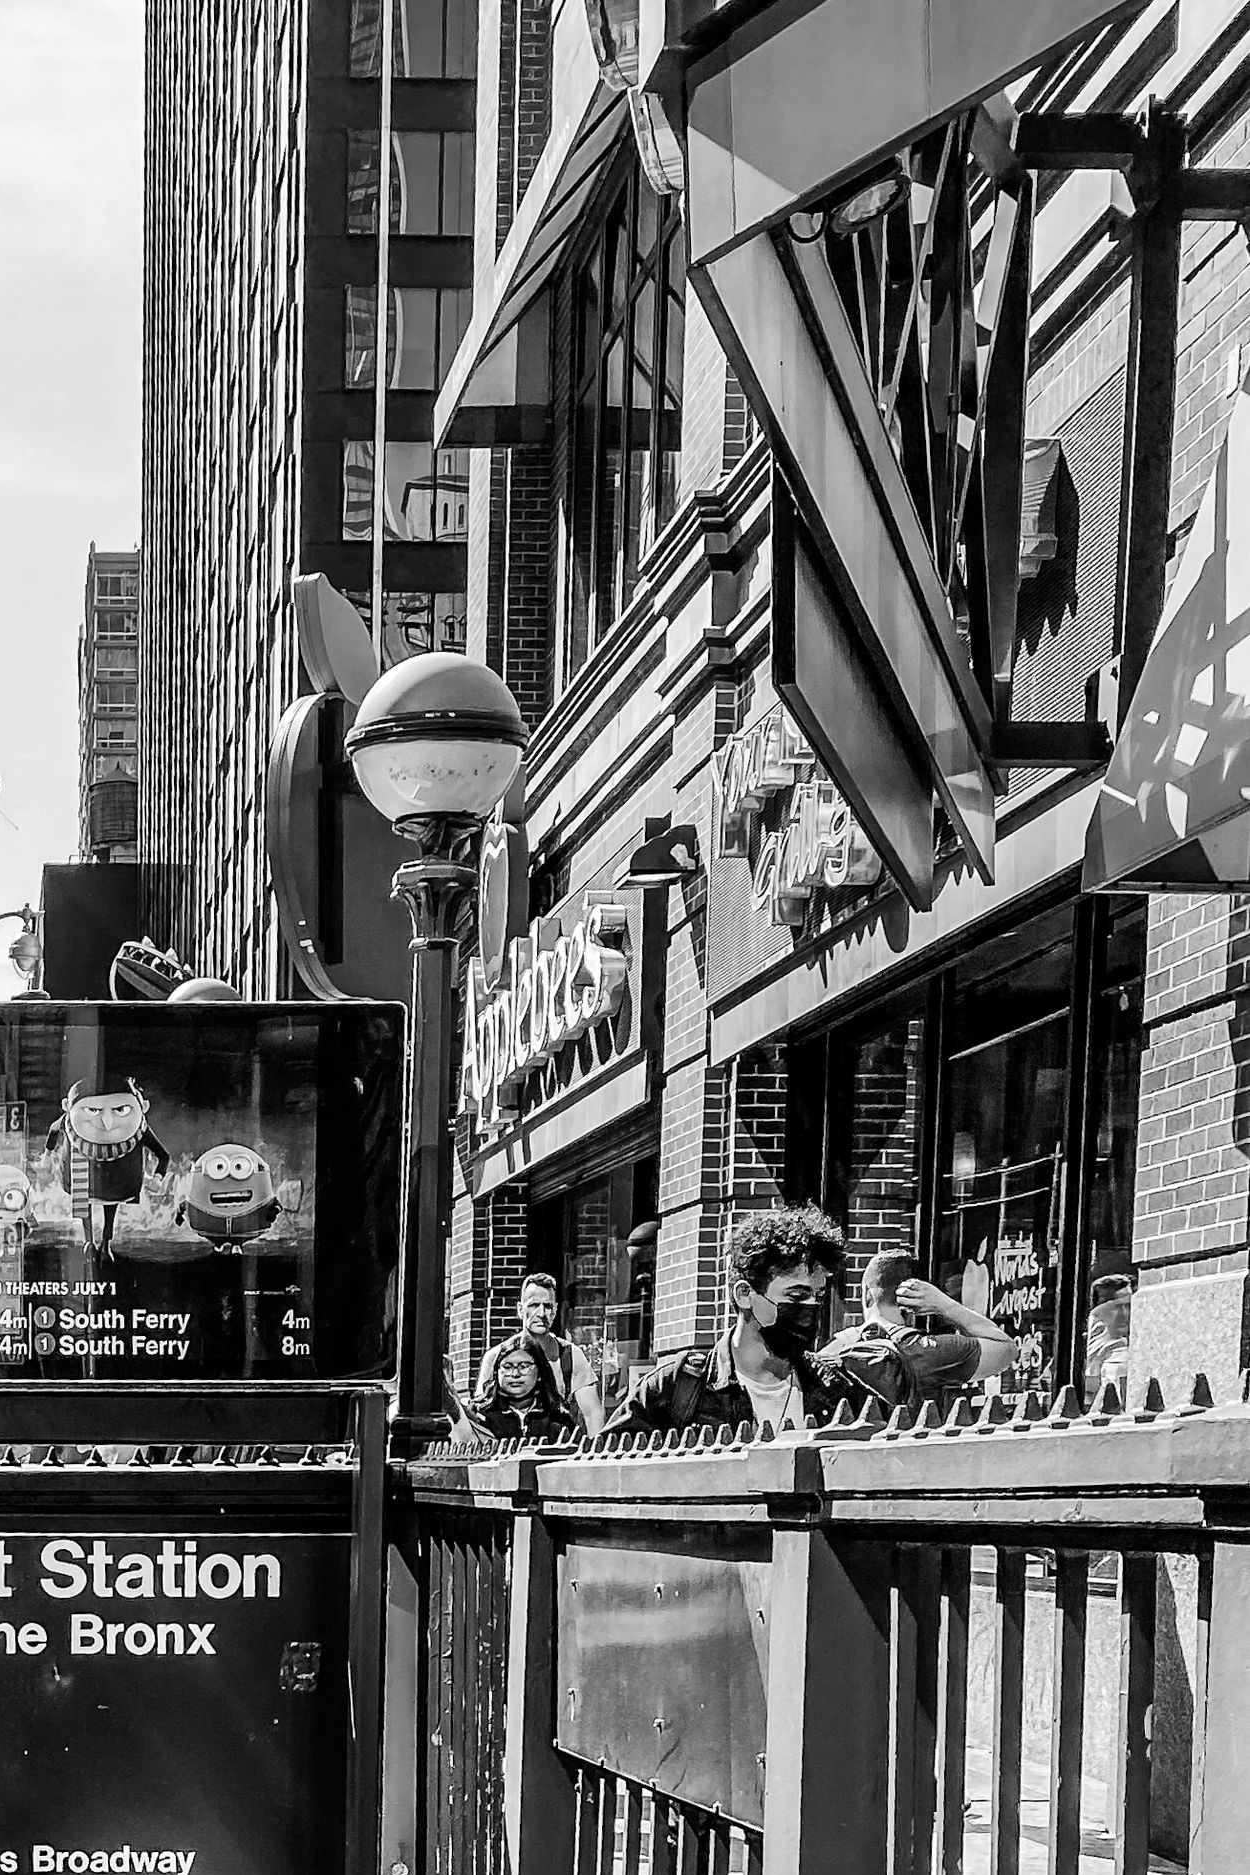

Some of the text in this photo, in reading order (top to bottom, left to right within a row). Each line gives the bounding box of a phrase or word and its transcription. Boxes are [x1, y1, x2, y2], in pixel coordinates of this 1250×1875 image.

[6, 1282, 68, 1295] THEATERS
[72, 1282, 107, 1295] JULY
[110, 1282, 117, 1295] 1
[990, 1268, 1047, 1329] Largest
[0, 1308, 28, 1329] 4m
[59, 1309, 125, 1329] South
[132, 1309, 190, 1334] Ferry
[281, 1309, 311, 1329] 4m
[59, 1336, 125, 1355] South
[132, 1336, 190, 1360] Ferry
[281, 1336, 311, 1355] 8m
[40, 1539, 282, 1599] Station
[70, 1613, 217, 1656] Bronx
